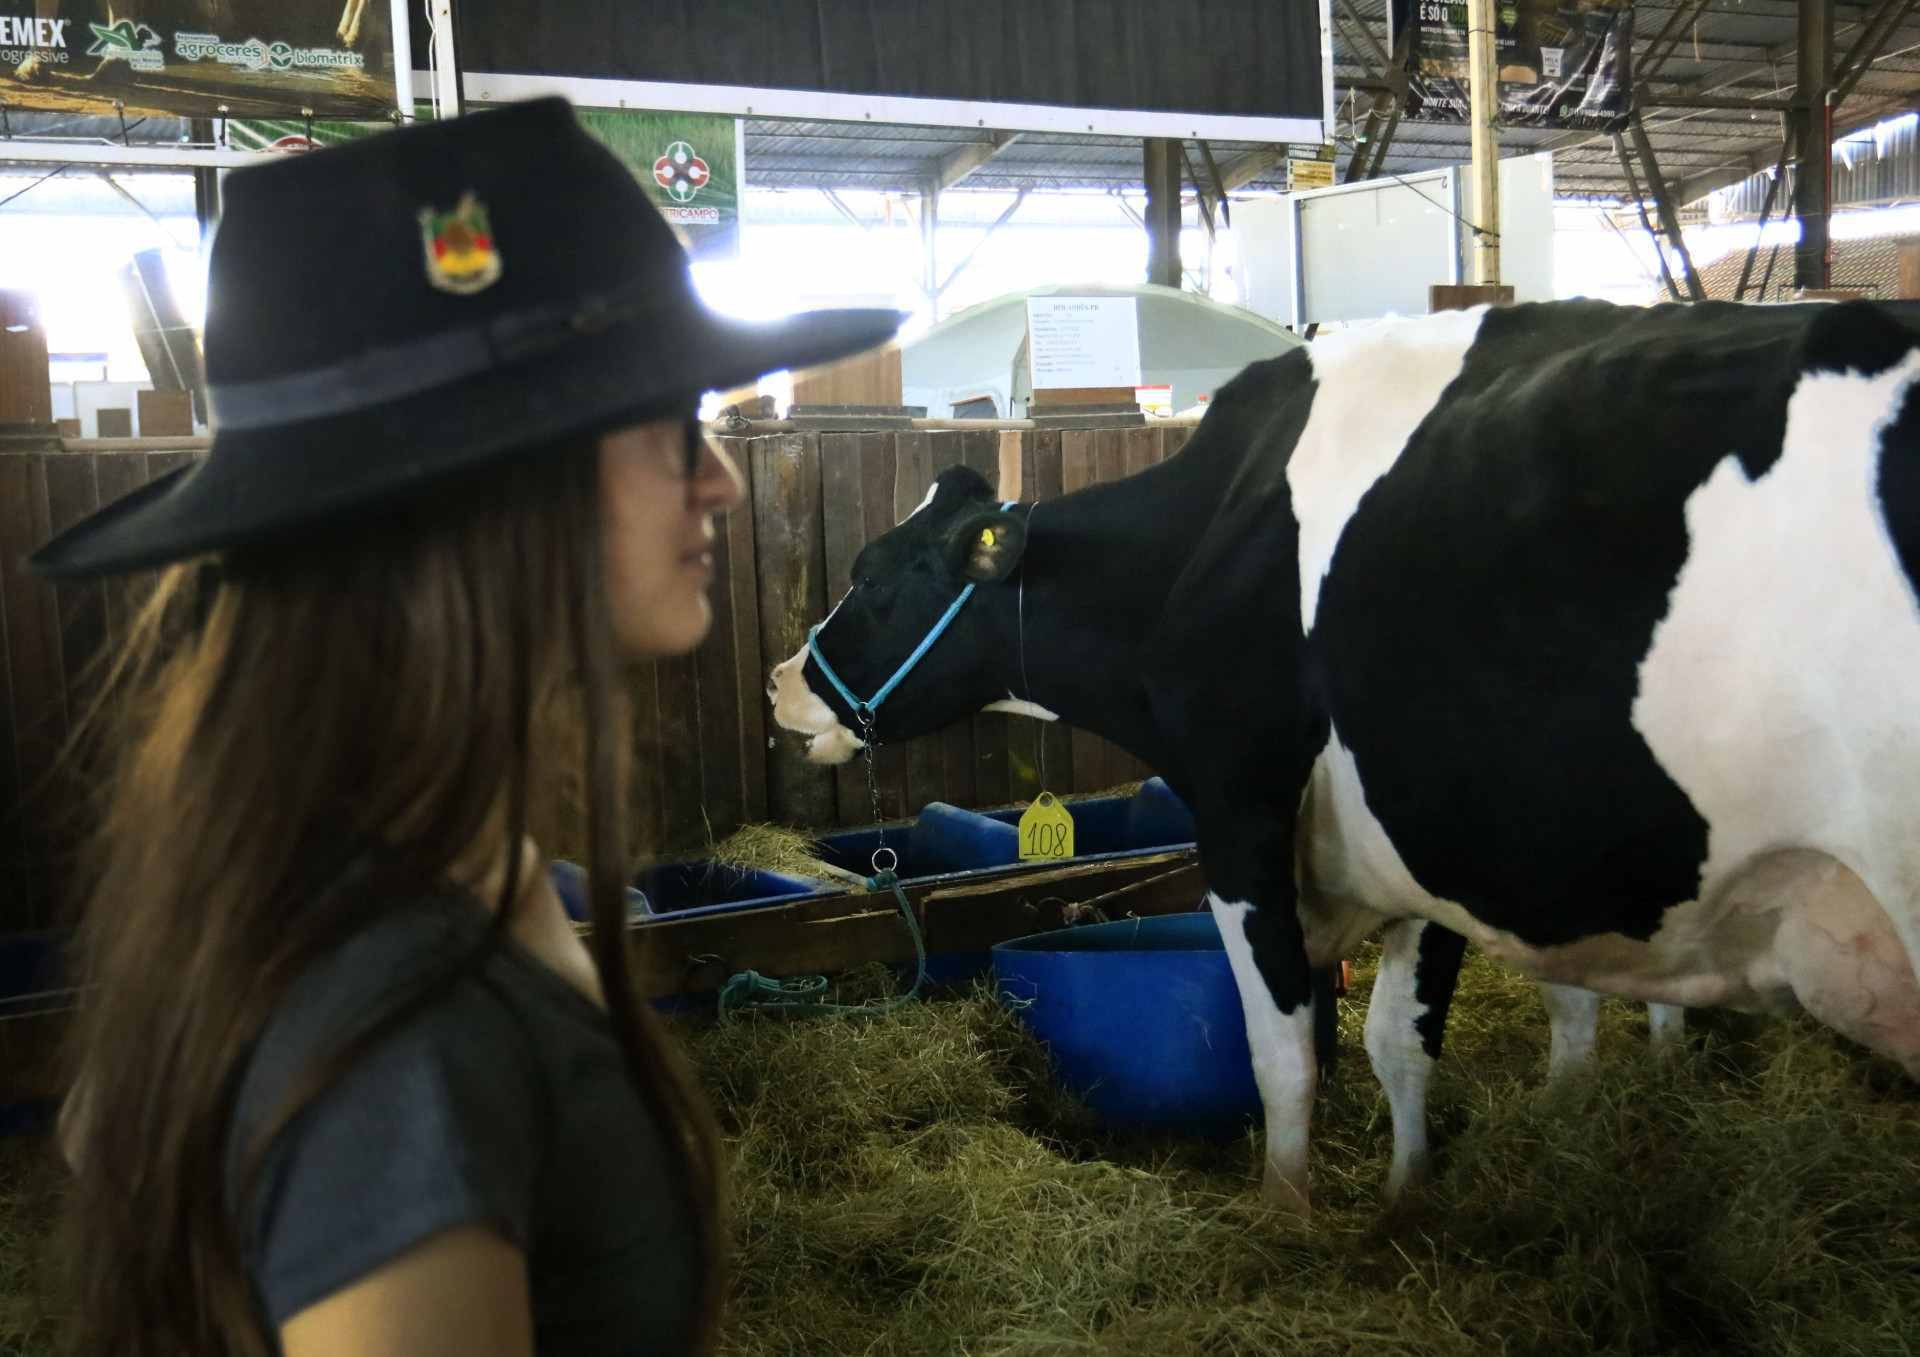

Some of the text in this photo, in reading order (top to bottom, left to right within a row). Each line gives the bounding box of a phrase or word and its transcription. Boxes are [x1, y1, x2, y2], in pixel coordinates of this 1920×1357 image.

[1428, 4, 1440, 21] SÓ
[0, 16, 66, 48] EMEX
[178, 42, 261, 59] agroceres
[296, 50, 362, 65] biomatrix
[1024, 822, 1067, 857] 108
